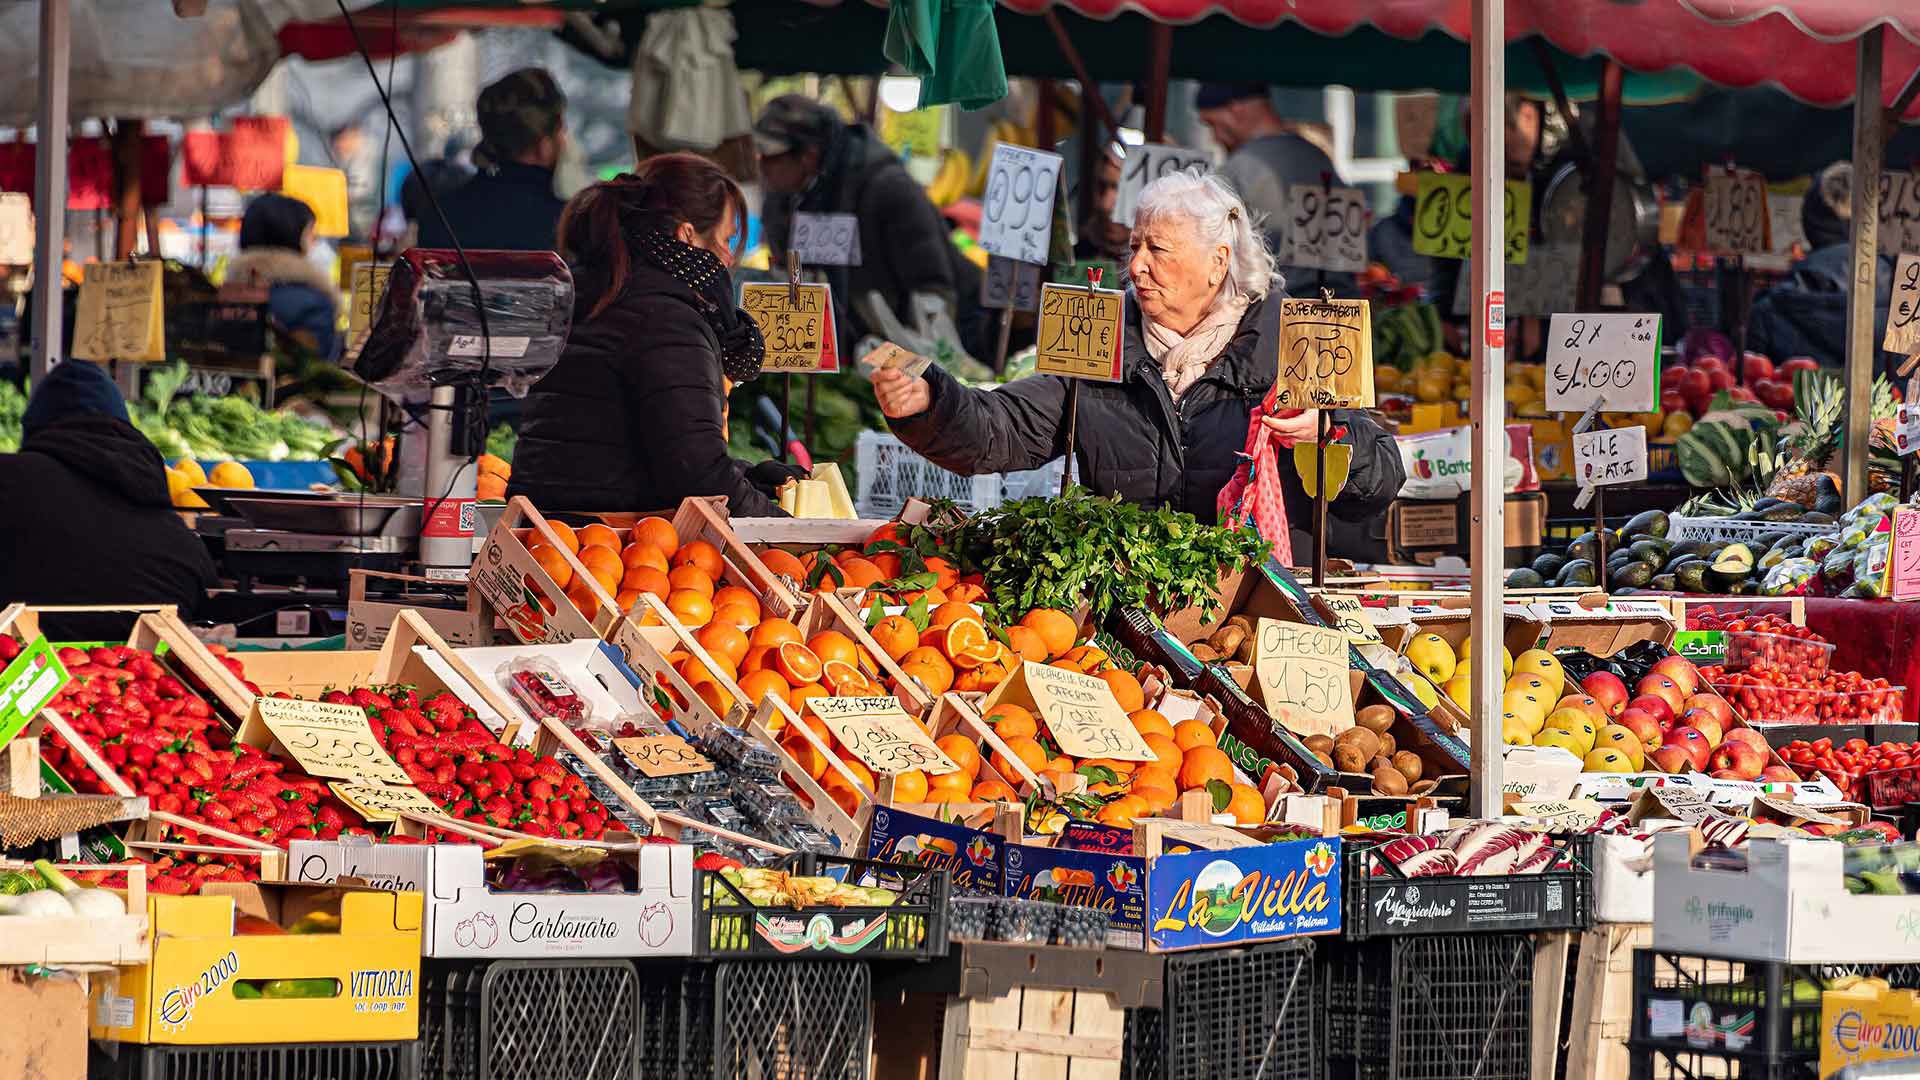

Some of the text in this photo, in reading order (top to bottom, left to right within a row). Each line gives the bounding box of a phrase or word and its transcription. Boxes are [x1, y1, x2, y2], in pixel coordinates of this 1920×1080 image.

[1065, 296, 1106, 319] ITALIA
[1100, 326, 1111, 345] €
[1564, 319, 1586, 348] 2
[1263, 625, 1344, 657] OFFERTA
[1153, 878, 1215, 933] La
[1231, 869, 1331, 924] Villa
[509, 902, 620, 943] Carbonaro
[350, 969, 414, 998] VITTORIA
